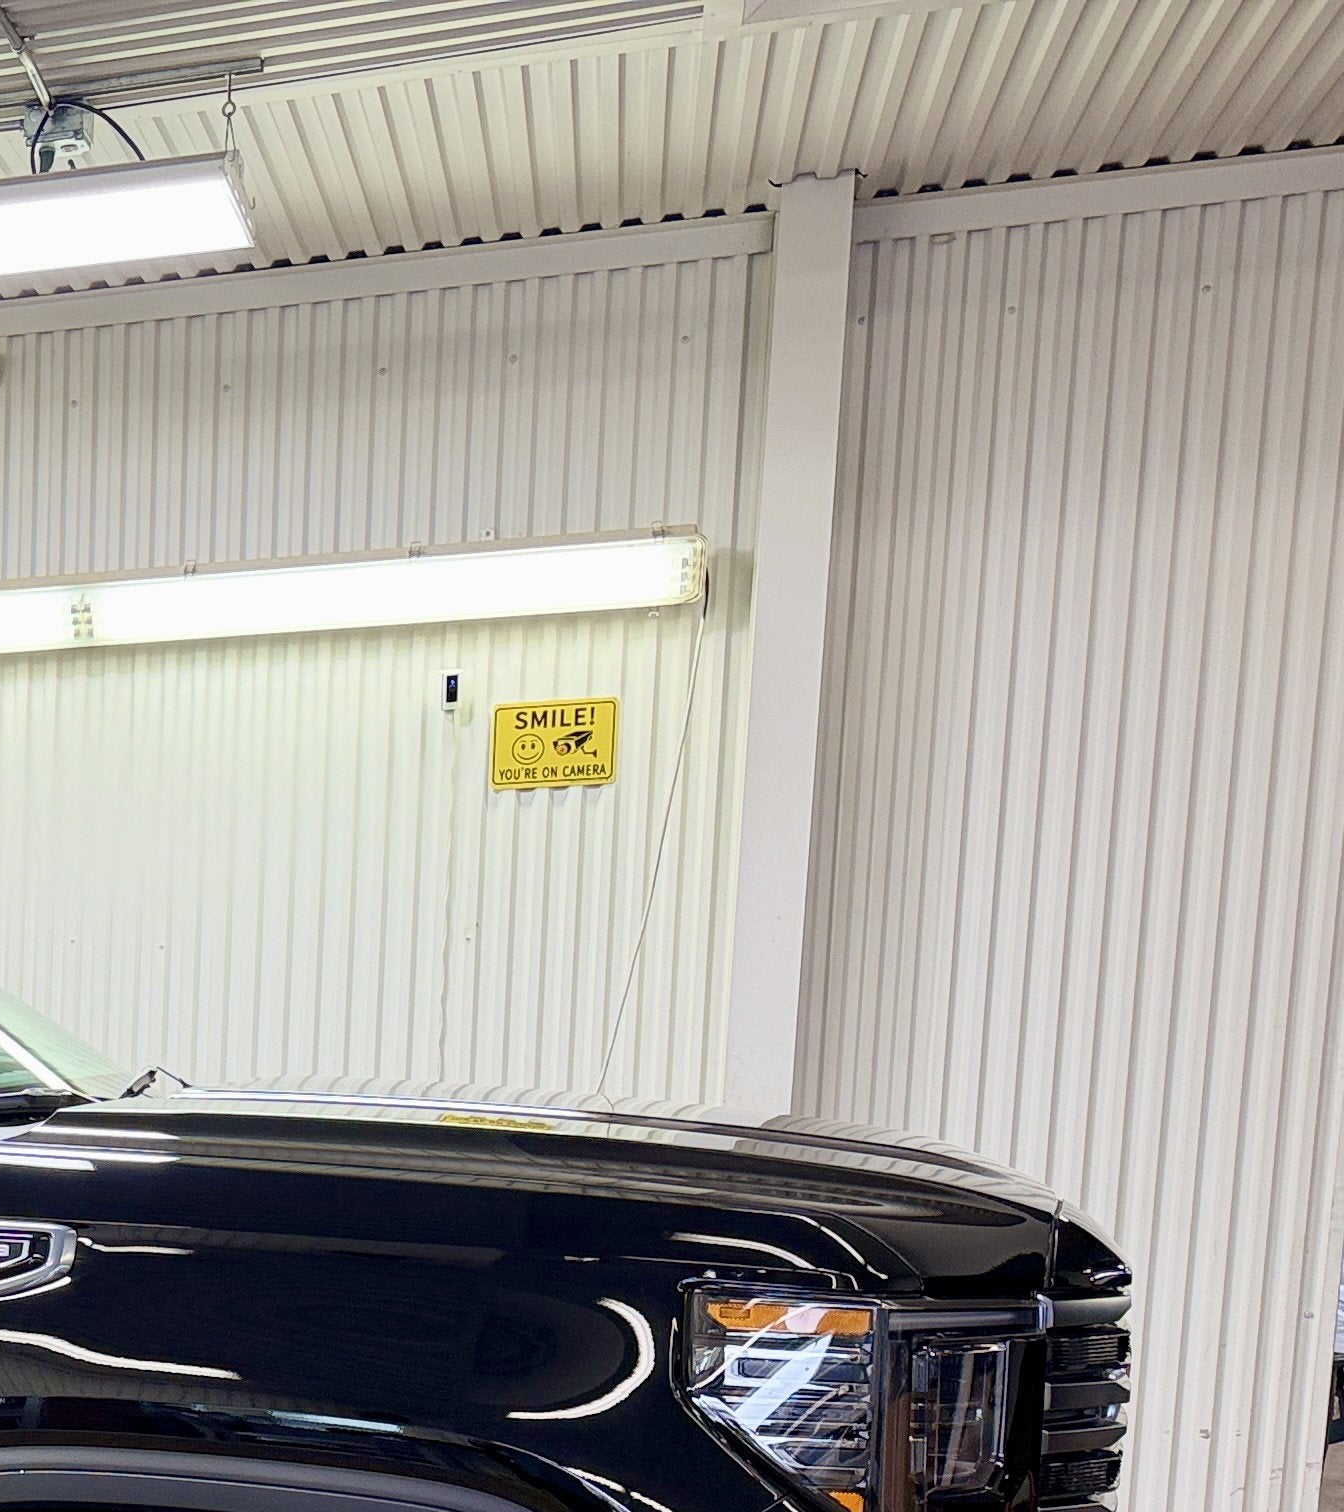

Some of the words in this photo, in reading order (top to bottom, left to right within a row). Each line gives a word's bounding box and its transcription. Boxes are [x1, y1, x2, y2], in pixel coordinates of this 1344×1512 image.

[514, 707, 595, 730] SMILE!
[499, 767, 538, 781] YOU'RE
[542, 766, 558, 778] ON
[562, 763, 607, 777] CAMERA
